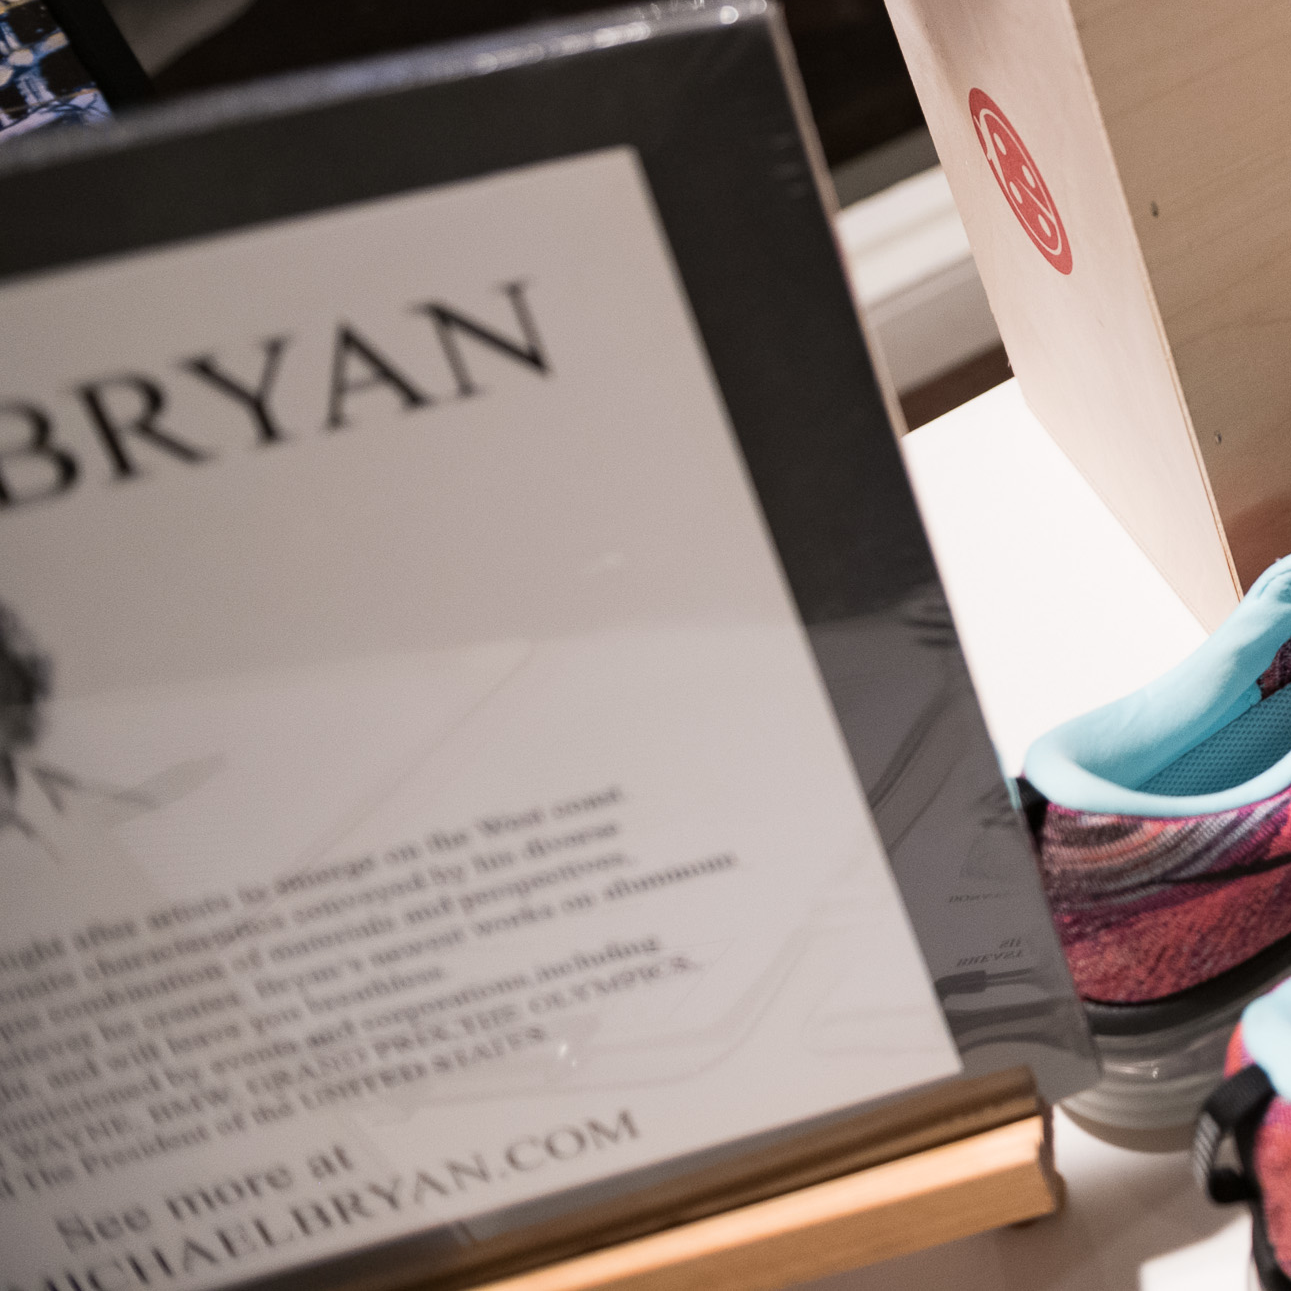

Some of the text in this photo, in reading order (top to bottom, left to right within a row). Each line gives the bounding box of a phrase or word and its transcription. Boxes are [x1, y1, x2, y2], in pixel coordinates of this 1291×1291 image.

[55, 1144, 355, 1255] See more at
